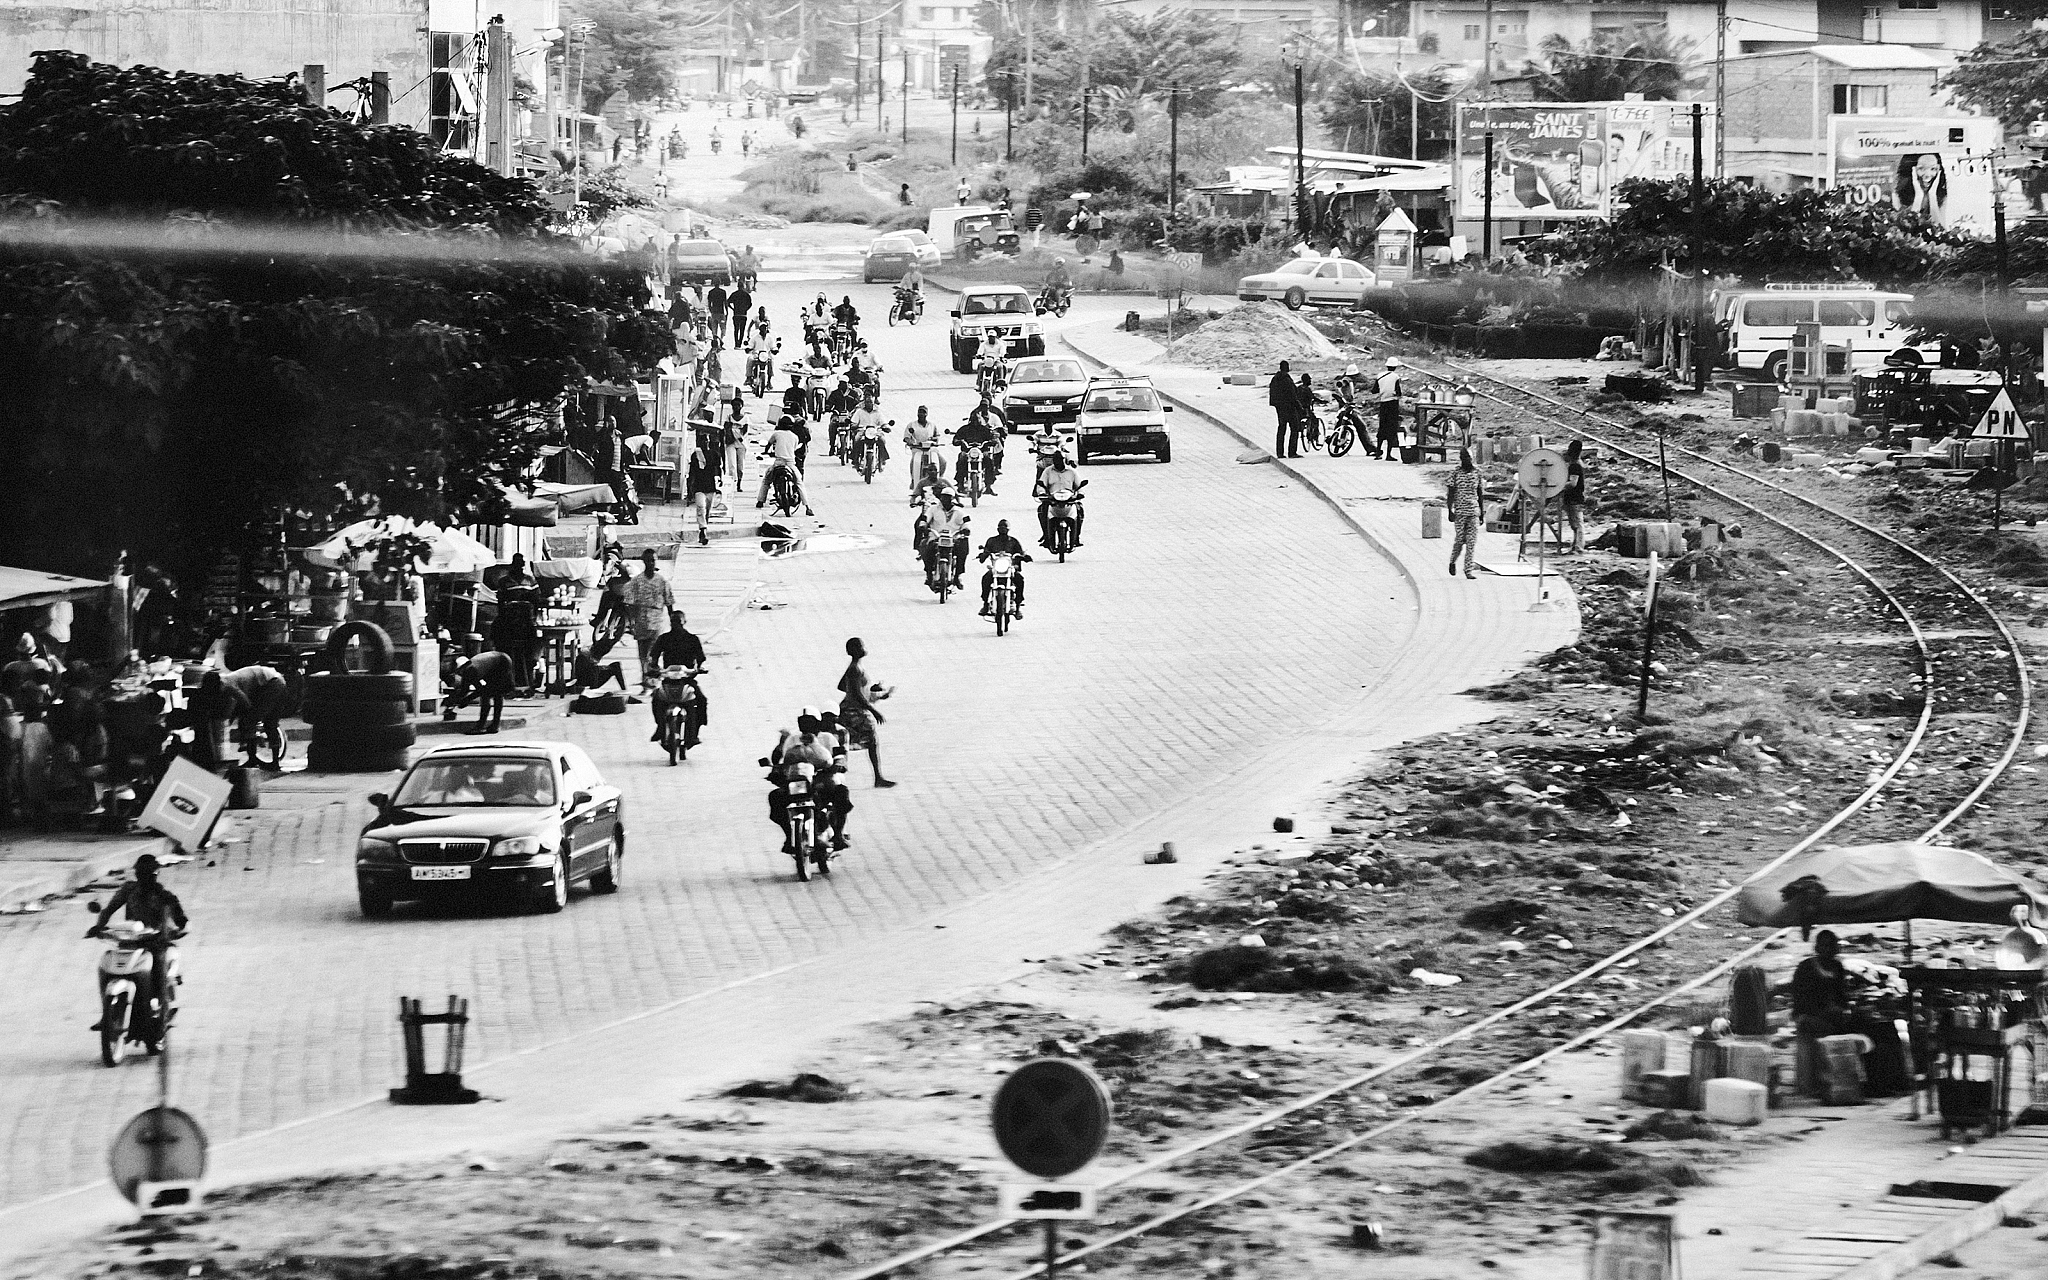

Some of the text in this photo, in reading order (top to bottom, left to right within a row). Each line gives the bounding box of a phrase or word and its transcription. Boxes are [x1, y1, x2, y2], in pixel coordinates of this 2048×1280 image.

[1532, 112, 1583, 126] SAINT
[1528, 125, 1584, 139] JAMES
[1858, 138, 1891, 148] 100%
[1986, 409, 2016, 435] PN
